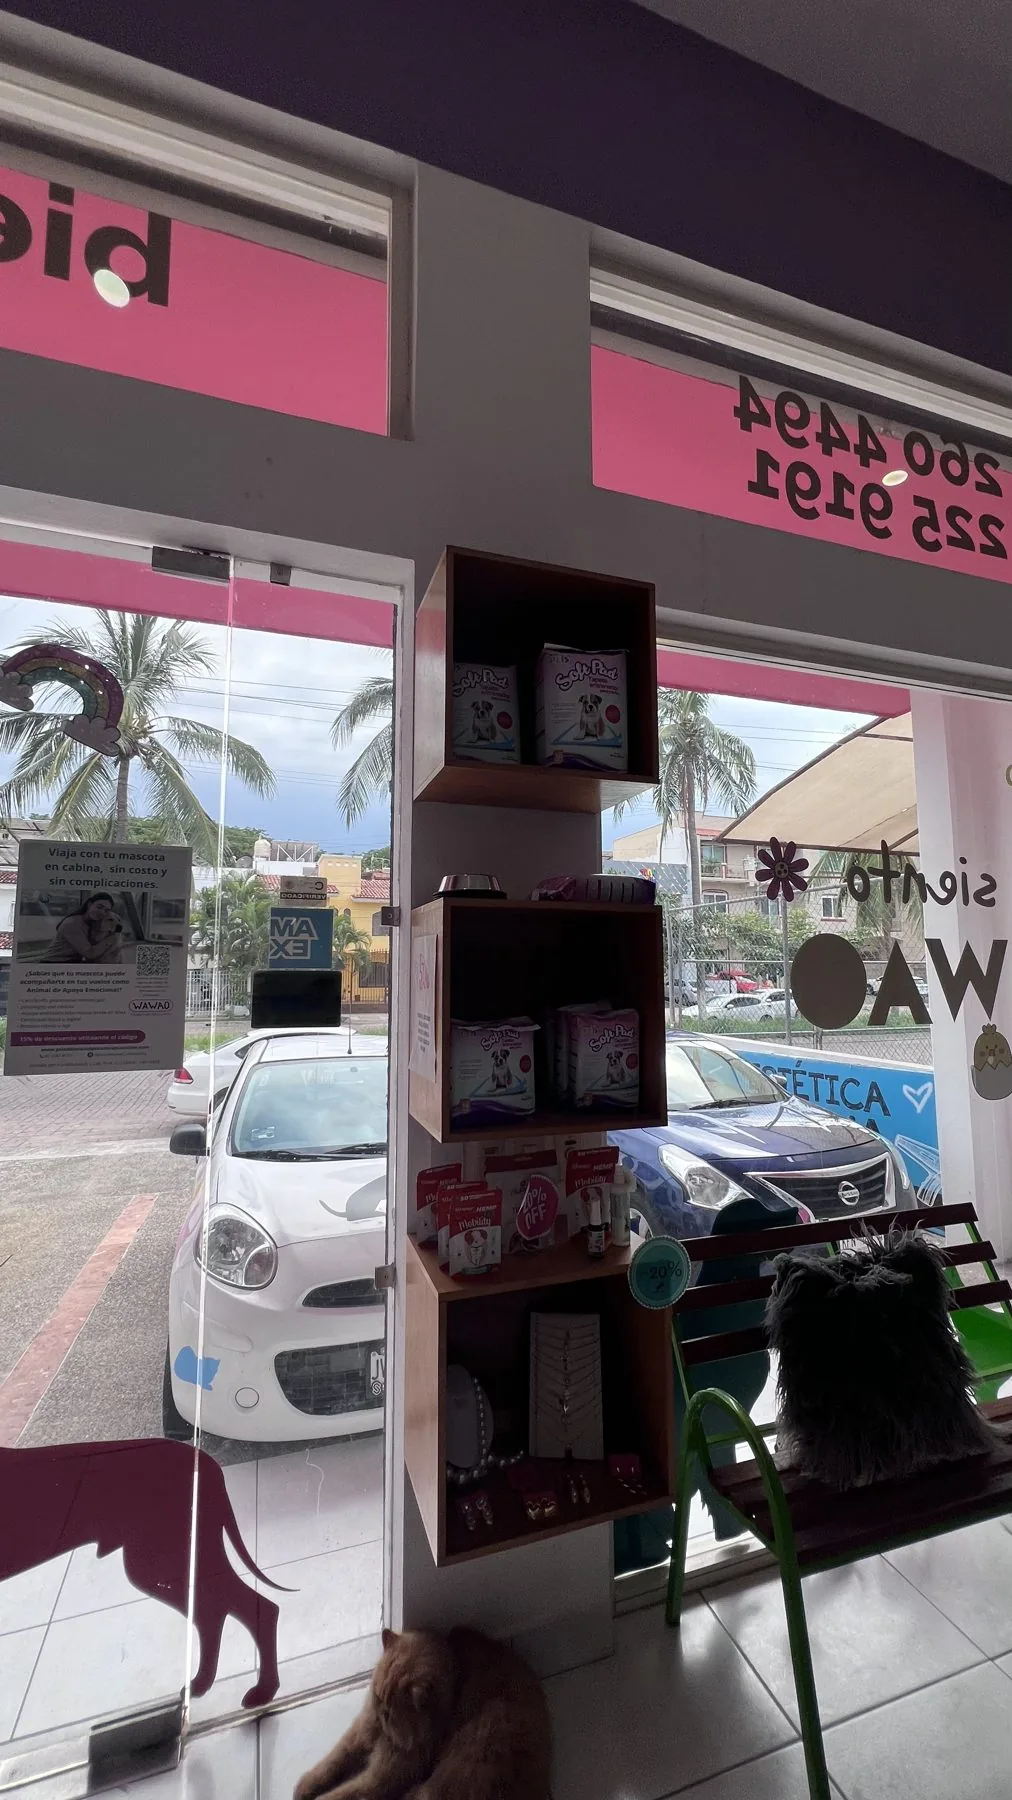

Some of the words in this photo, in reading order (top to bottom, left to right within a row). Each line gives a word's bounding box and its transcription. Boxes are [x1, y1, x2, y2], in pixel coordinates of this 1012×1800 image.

[48, 847, 76, 859] Viaja
[80, 850, 100, 859] con
[103, 850, 116, 859] tu
[118, 851, 165, 862] mascota
[45, 863, 59, 871] en
[62, 863, 103, 874] cabina,
[109, 864, 126, 874] sin
[128, 867, 158, 875] costo
[160, 868, 168, 878] y
[49, 876, 66, 886] sin
[69, 877, 159, 889] complicaciones.
